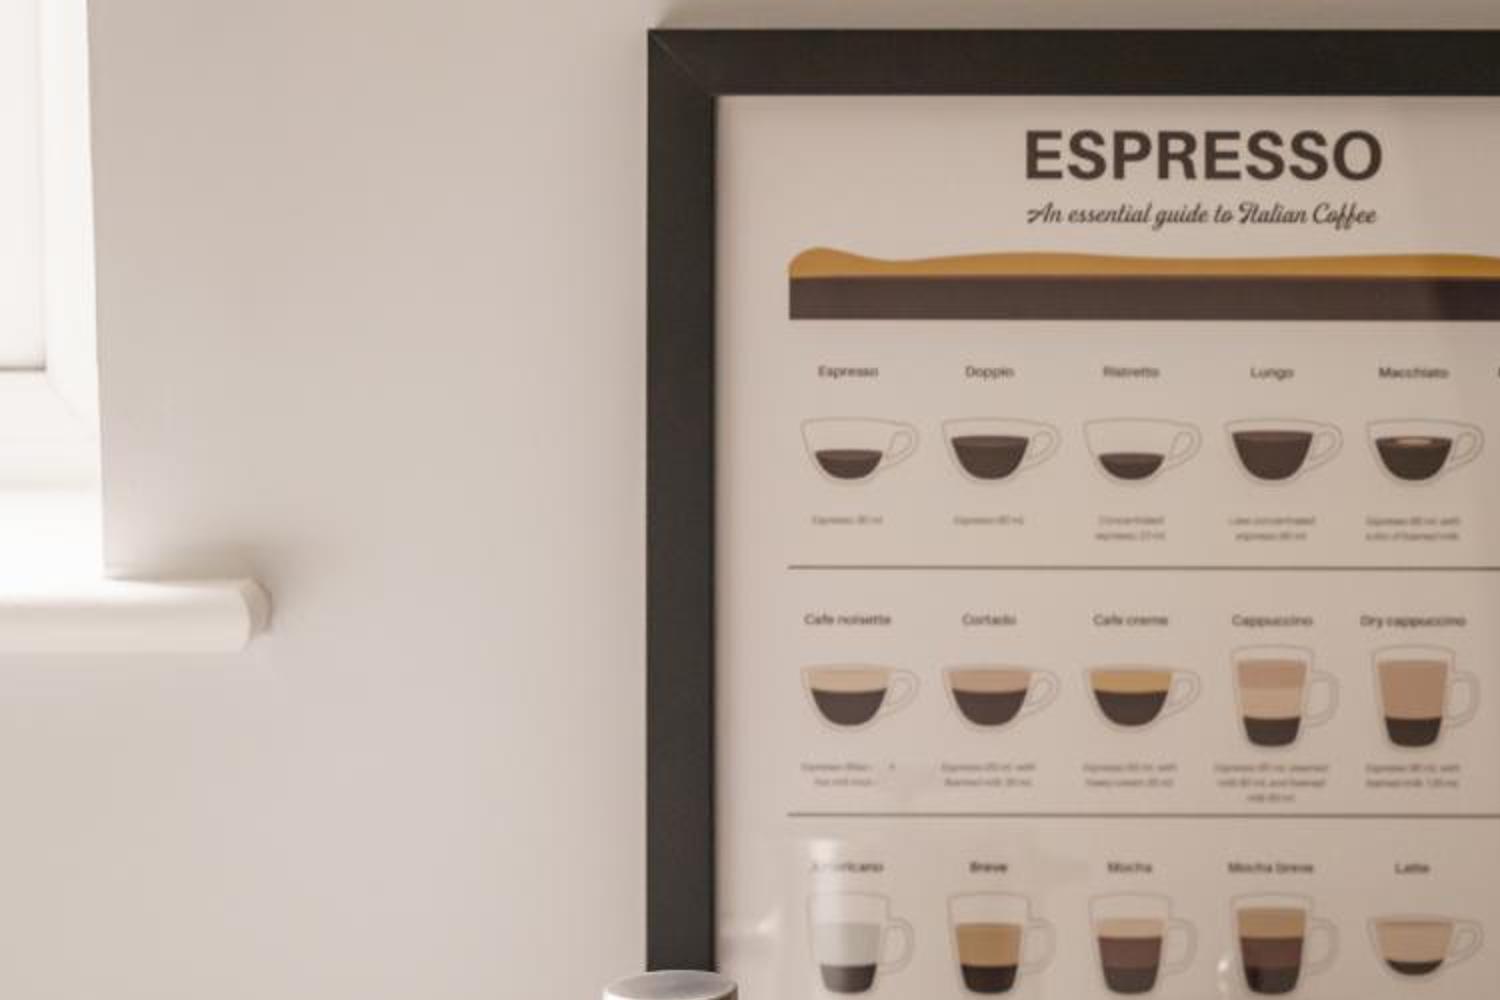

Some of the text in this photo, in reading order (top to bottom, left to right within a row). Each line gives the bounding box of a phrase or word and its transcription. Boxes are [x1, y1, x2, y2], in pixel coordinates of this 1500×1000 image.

[1025, 129, 1383, 182] ESPRESSO
[1027, 201, 1378, 231] An essential guide to Italian Coffee
[817, 364, 880, 381] Espresso
[964, 364, 1016, 382] Doppio
[1250, 366, 1295, 382] Lungo
[1378, 365, 1450, 380] Macchiato
[961, 612, 1018, 627] Cortado
[1231, 613, 1314, 630] Cappuccino
[1360, 614, 1467, 630] Dry cappuccino
[811, 860, 885, 875] Aricano
[969, 860, 1009, 875] Breve
[1106, 860, 1153, 875] Mocha
[1227, 861, 1273, 875] Mocha
[1394, 862, 1431, 875] Latte
